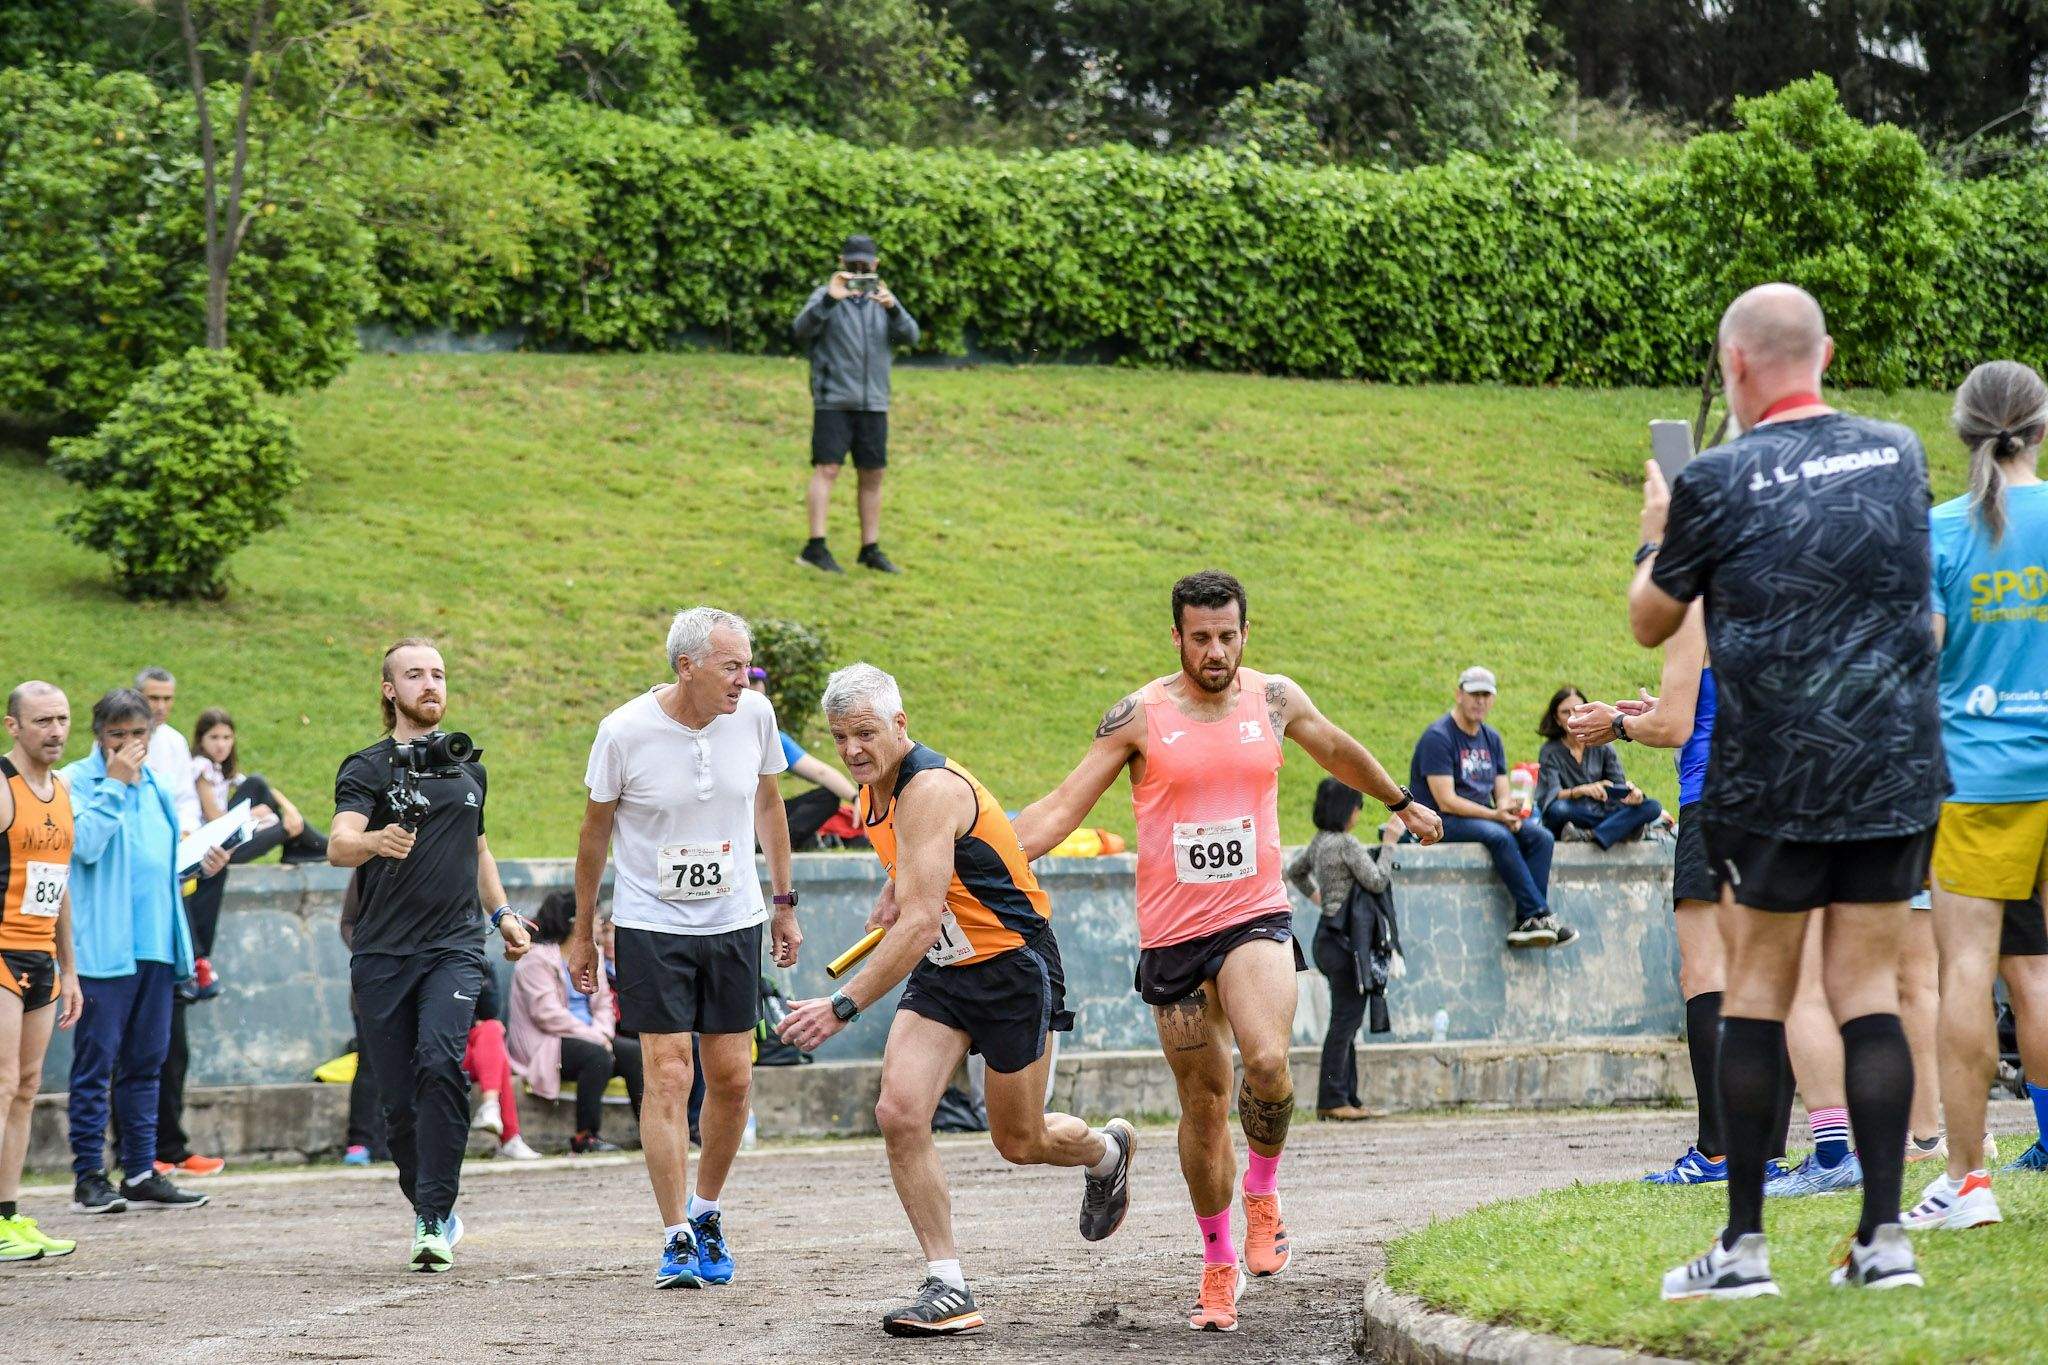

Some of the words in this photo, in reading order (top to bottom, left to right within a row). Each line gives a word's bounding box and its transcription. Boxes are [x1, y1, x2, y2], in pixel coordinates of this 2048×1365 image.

[1748, 471, 1773, 492] J.
[1189, 840, 1243, 870] 698
[672, 862, 722, 888] 783
